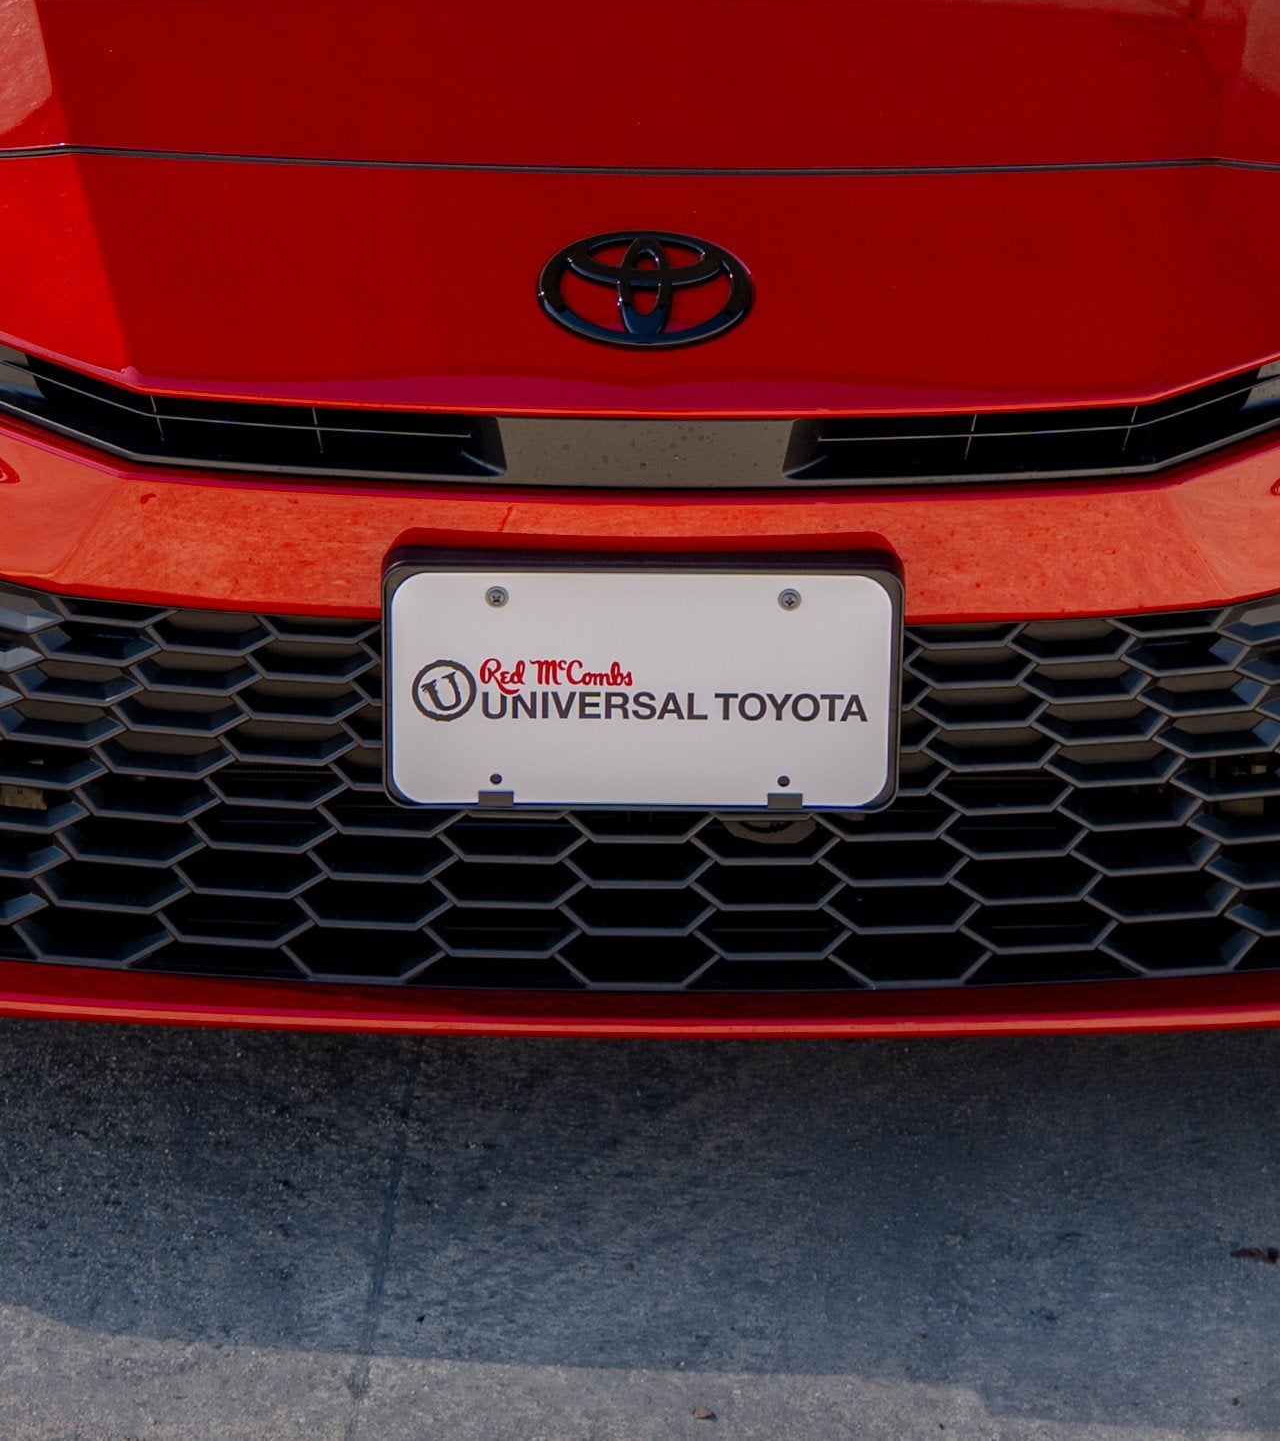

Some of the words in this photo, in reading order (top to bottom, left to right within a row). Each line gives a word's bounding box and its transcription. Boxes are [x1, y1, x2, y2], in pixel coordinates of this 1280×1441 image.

[479, 658, 525, 695] Red
[529, 659, 633, 687] McCombs
[481, 690, 708, 721] UNIVERSAL
[714, 691, 869, 723] TOYOTA
